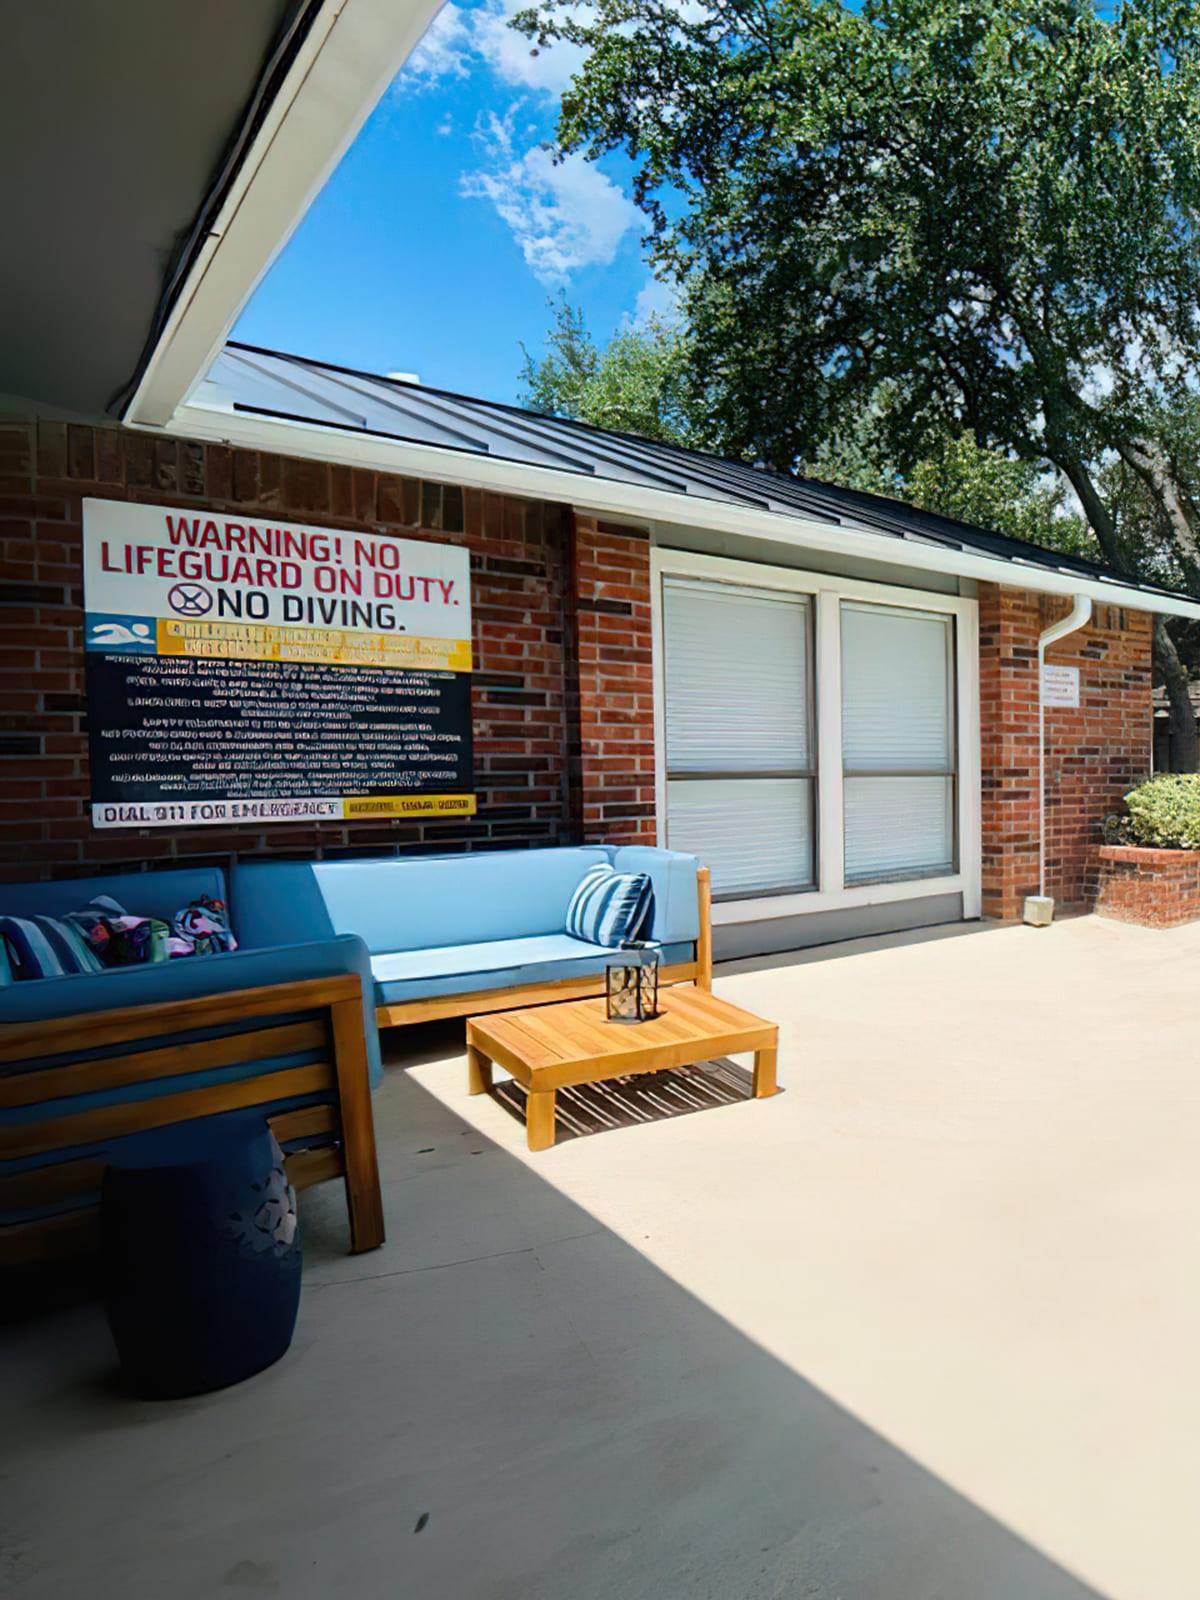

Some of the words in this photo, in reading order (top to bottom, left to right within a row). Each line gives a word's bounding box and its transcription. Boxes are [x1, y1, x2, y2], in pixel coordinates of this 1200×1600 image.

[165, 515, 342, 564] WARNING!
[354, 539, 400, 570] NO
[101, 541, 302, 590] LIFEGUARD
[314, 565, 362, 596] ON
[373, 571, 459, 606] DUTY.
[217, 588, 270, 620] NO
[282, 594, 406, 631] DIVING.
[104, 806, 150, 822] DIAL
